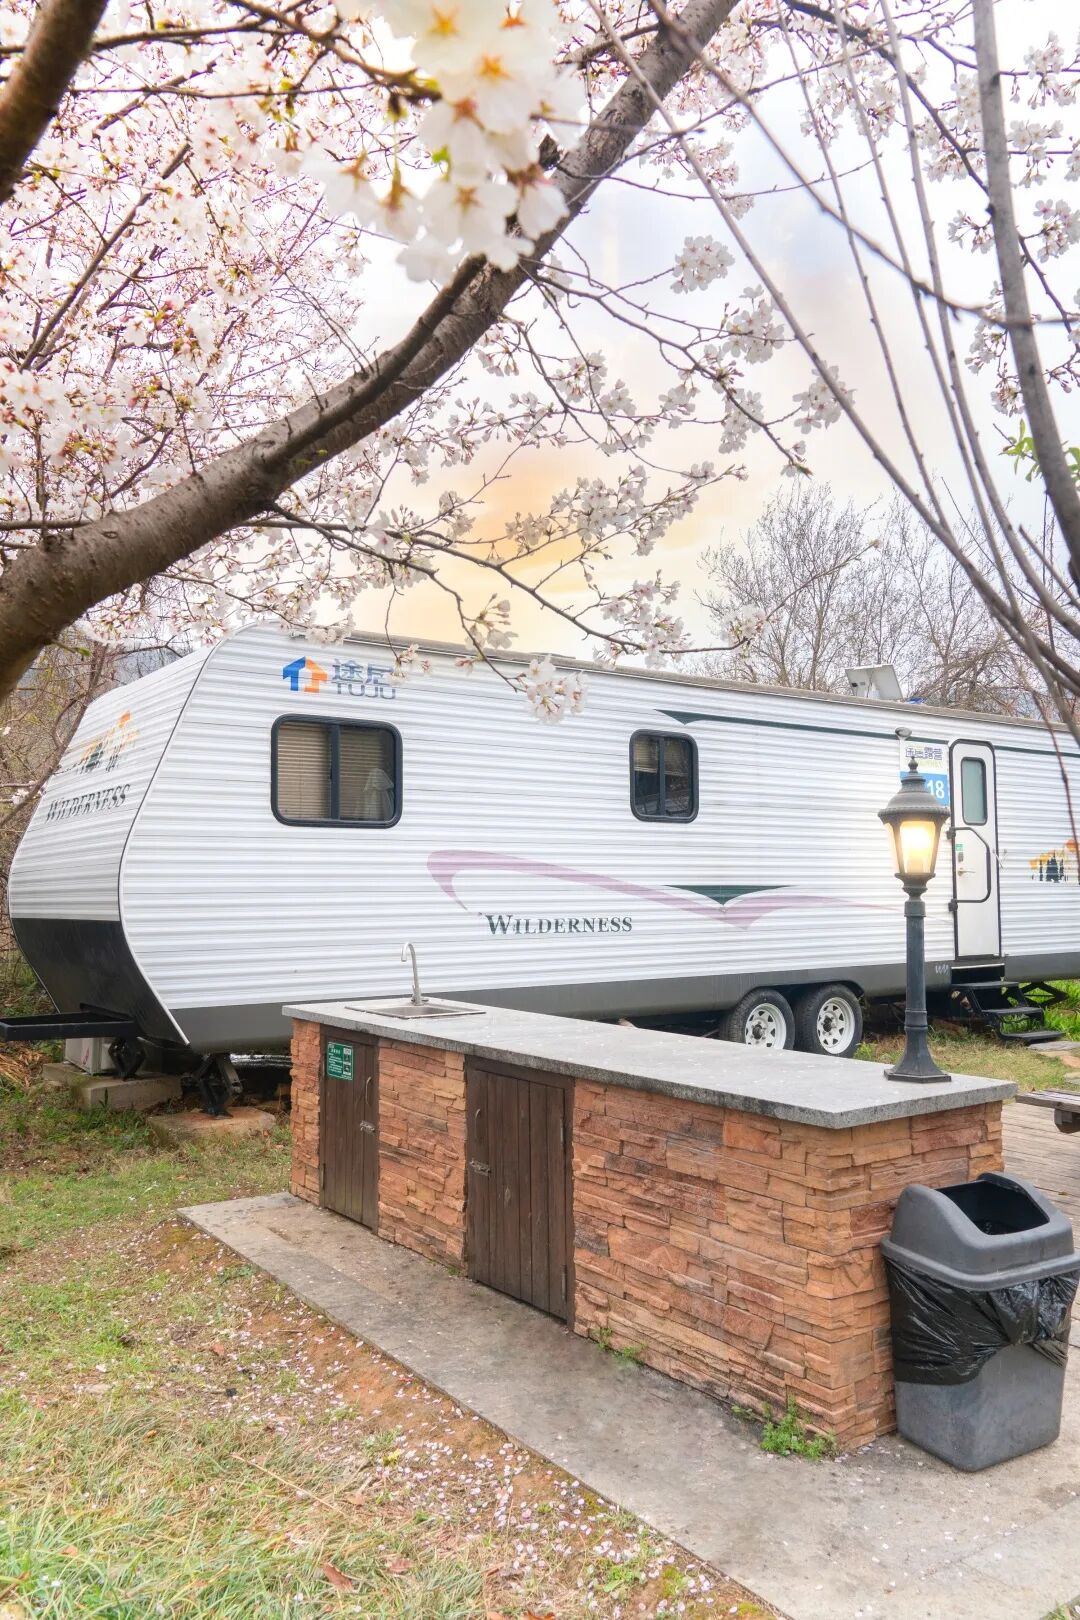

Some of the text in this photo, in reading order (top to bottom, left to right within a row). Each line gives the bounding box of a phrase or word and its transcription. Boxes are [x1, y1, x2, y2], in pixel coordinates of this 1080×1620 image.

[331, 681, 396, 700] TUJU
[926, 780, 945, 799] 18
[45, 784, 131, 823] WILDERNESS
[485, 914, 633, 935] WILDERNESS
